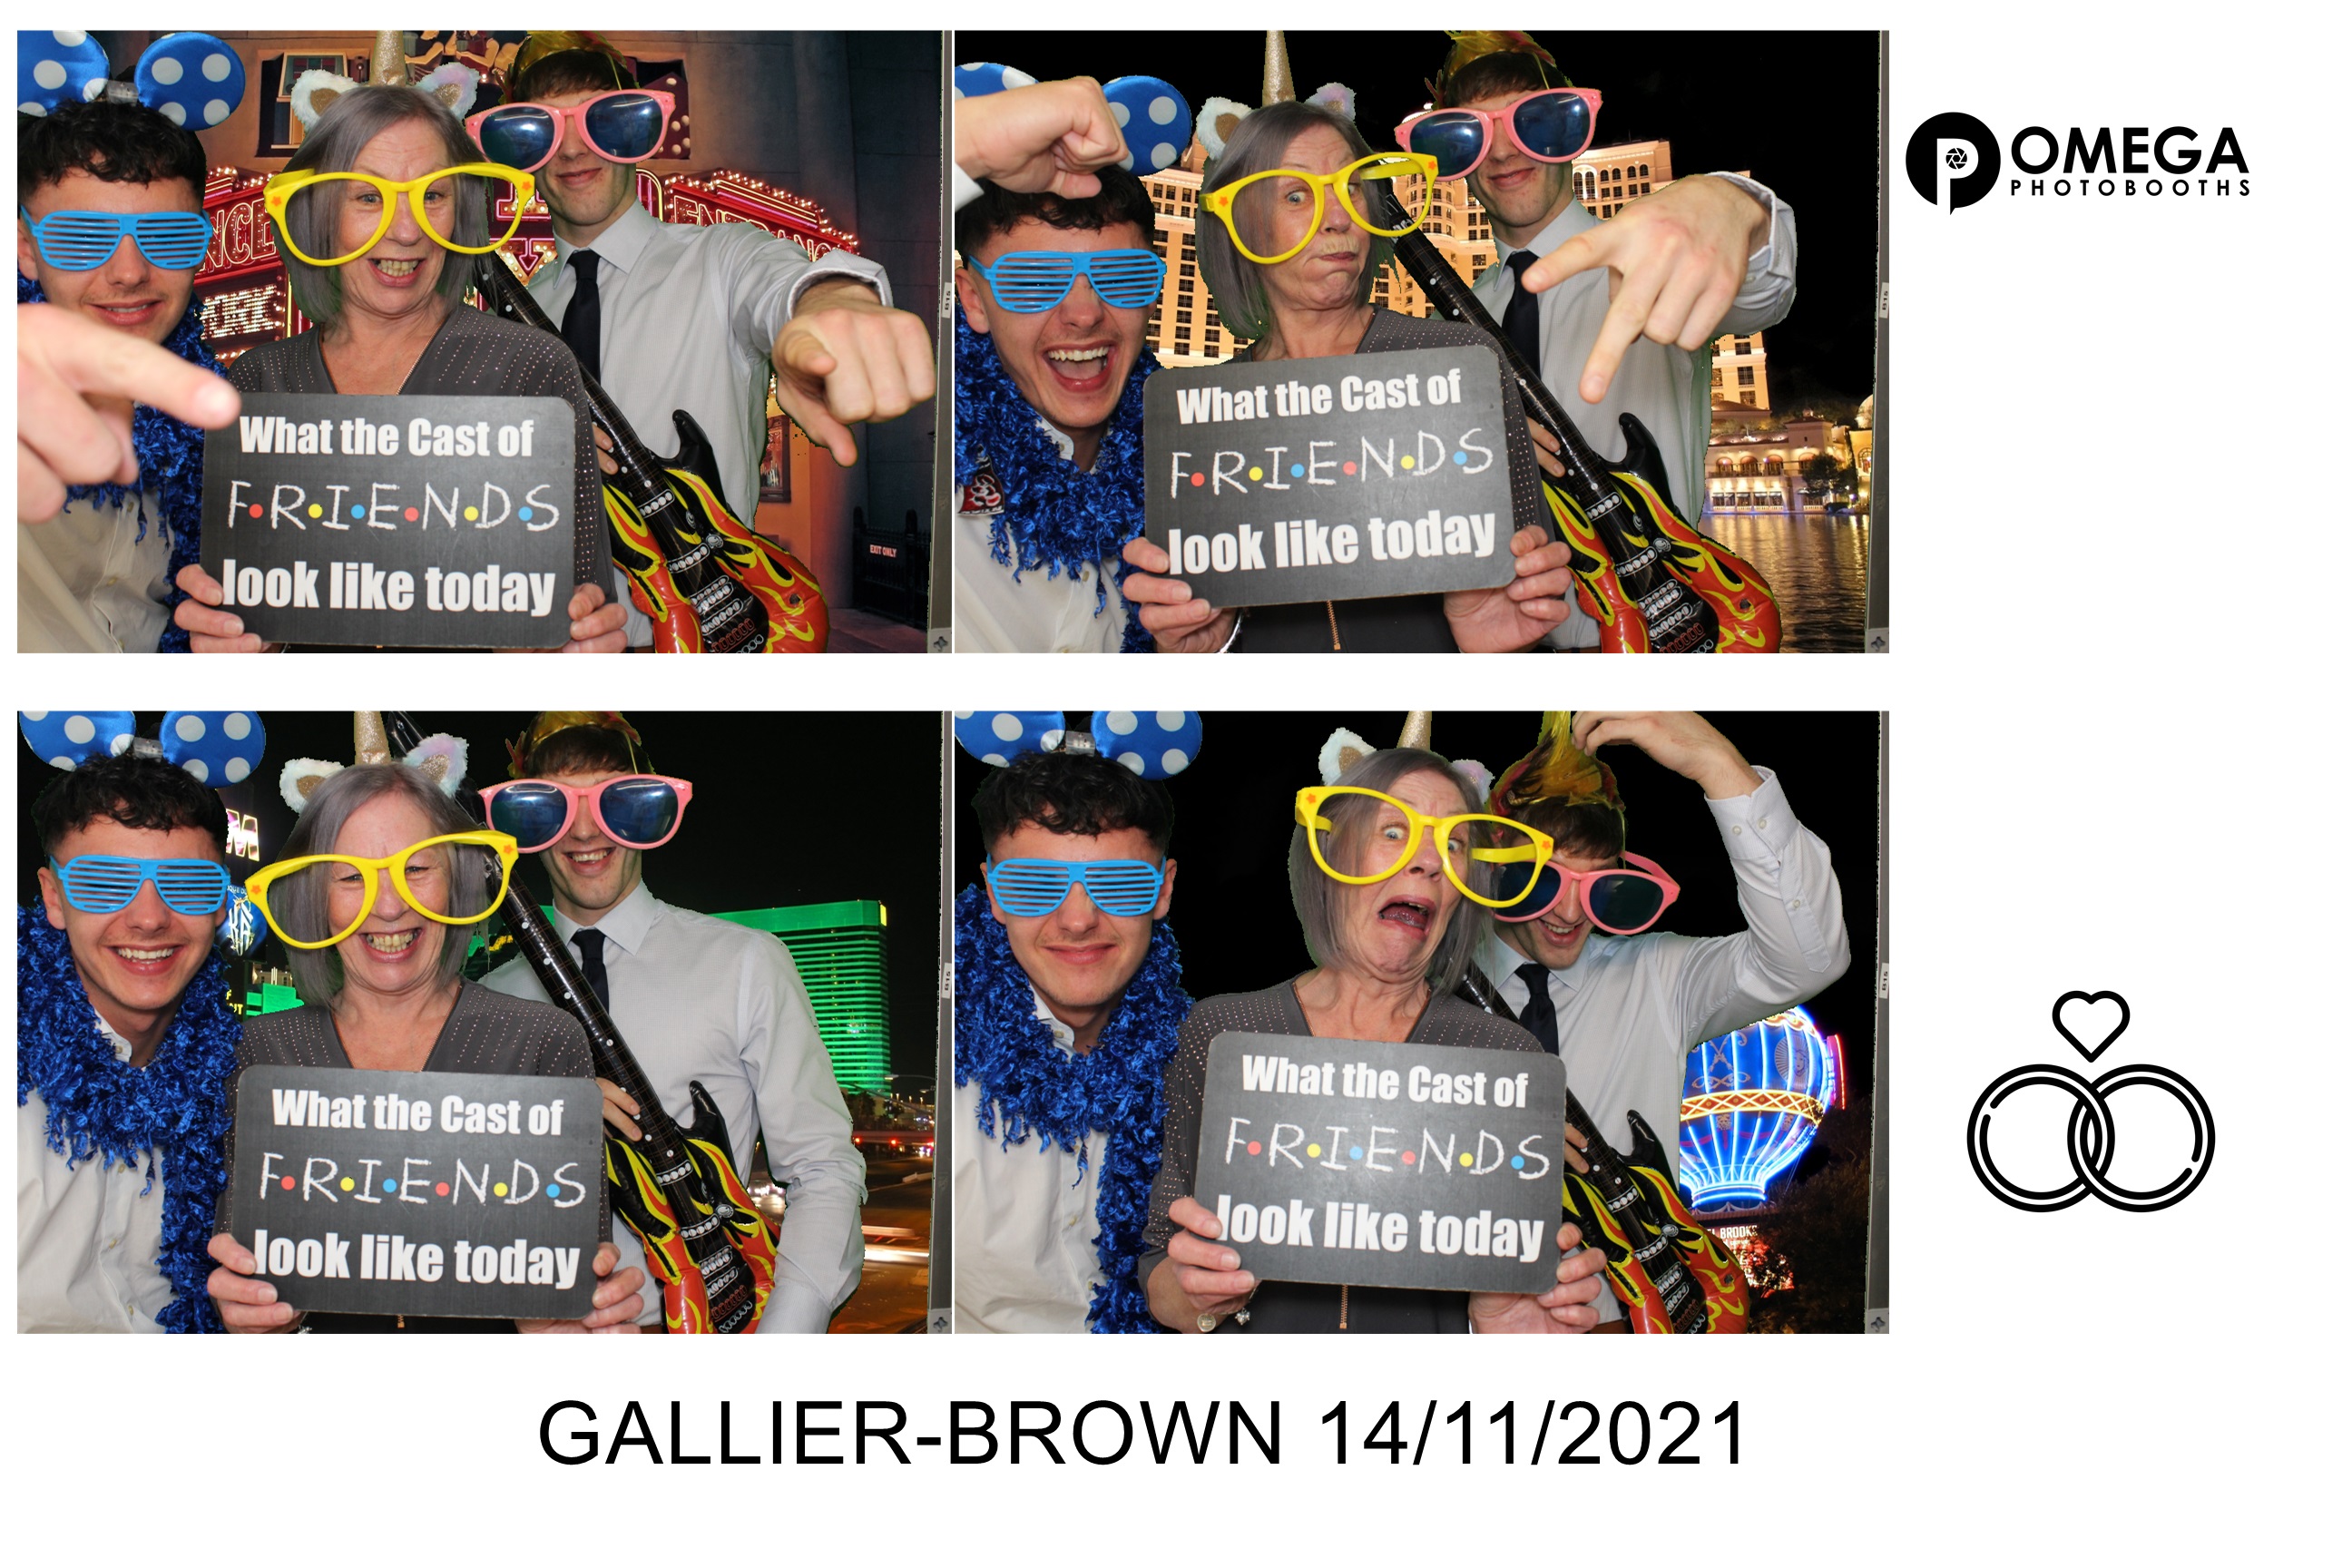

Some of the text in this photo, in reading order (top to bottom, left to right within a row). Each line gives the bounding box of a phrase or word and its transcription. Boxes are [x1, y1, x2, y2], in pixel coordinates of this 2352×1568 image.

[1177, 368, 1461, 425] What the Cast of
[240, 416, 534, 457] What the Cast of
[870, 544, 897, 558] EXIT ONLY
[1168, 509, 1496, 575] look like today
[223, 559, 556, 617] look like today
[1242, 1054, 1529, 1109] What the Cast of
[272, 1089, 564, 1136] What the Cast of
[1217, 1194, 1544, 1263] look like today
[254, 1229, 581, 1290] look like today
